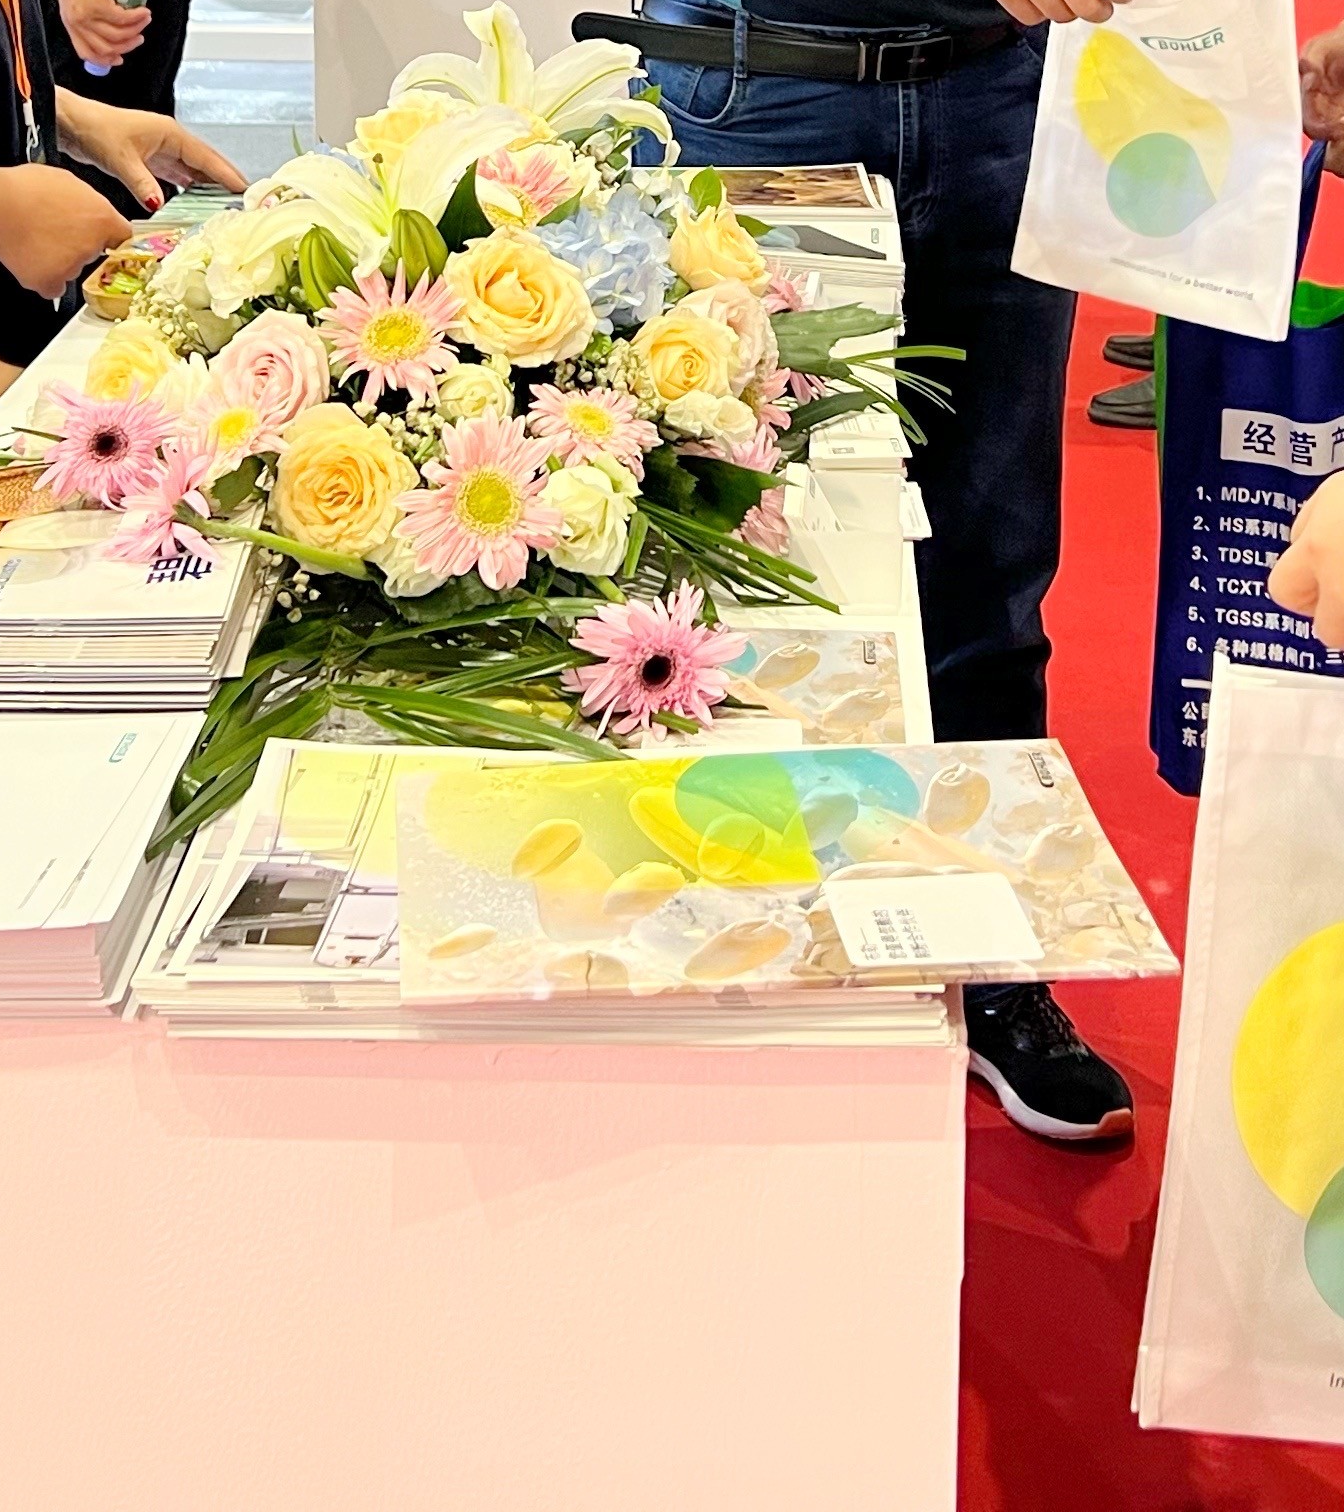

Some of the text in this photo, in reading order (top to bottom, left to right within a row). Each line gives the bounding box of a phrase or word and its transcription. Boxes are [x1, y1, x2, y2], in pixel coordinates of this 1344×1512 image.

[1196, 485, 1307, 517] 1、MDJY系列
[1187, 605, 1313, 639] 5、TGSS系列刮
